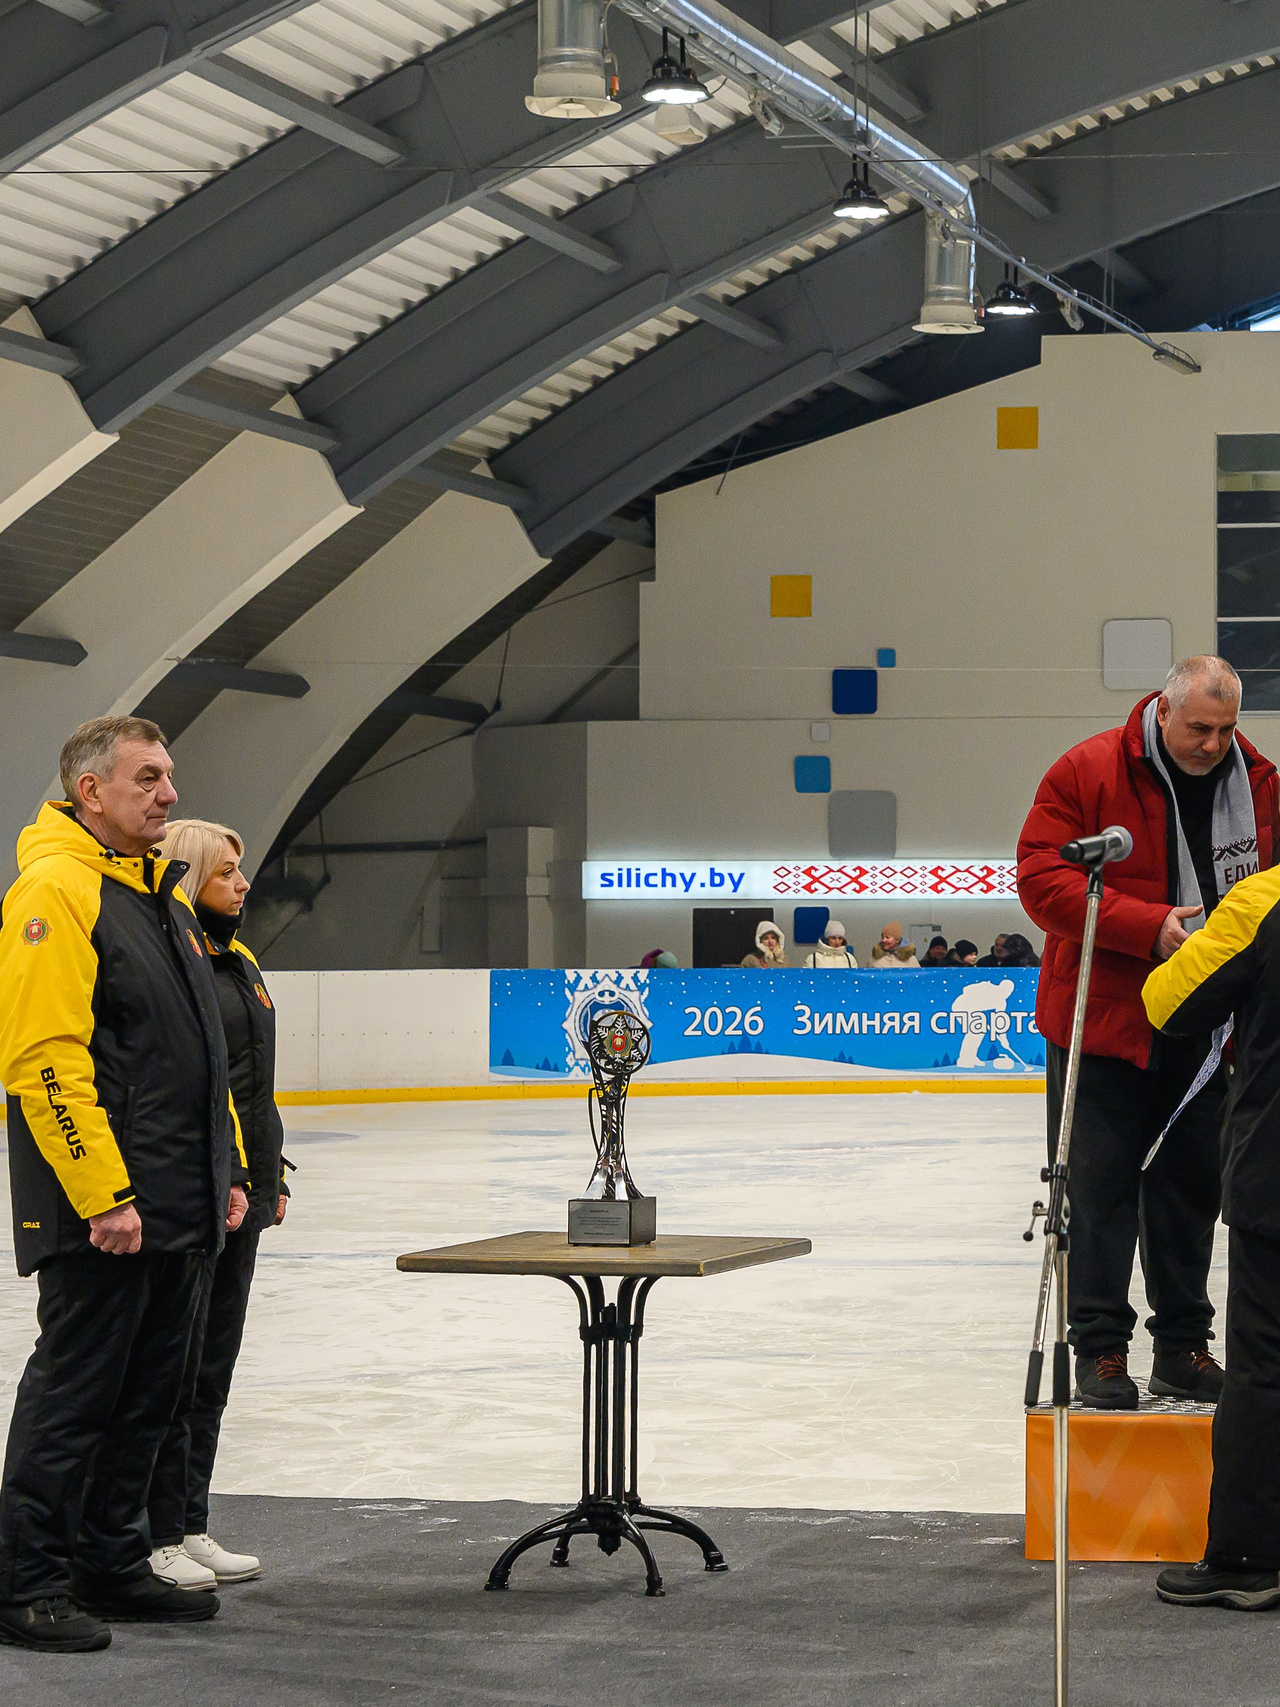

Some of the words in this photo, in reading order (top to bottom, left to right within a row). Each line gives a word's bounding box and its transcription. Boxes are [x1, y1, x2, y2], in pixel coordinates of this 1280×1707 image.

[600, 867, 746, 893] silichy.by
[683, 1005, 765, 1036] 2026
[792, 1004, 921, 1036] Зимняя
[40, 1066, 87, 1161] BELARUS
